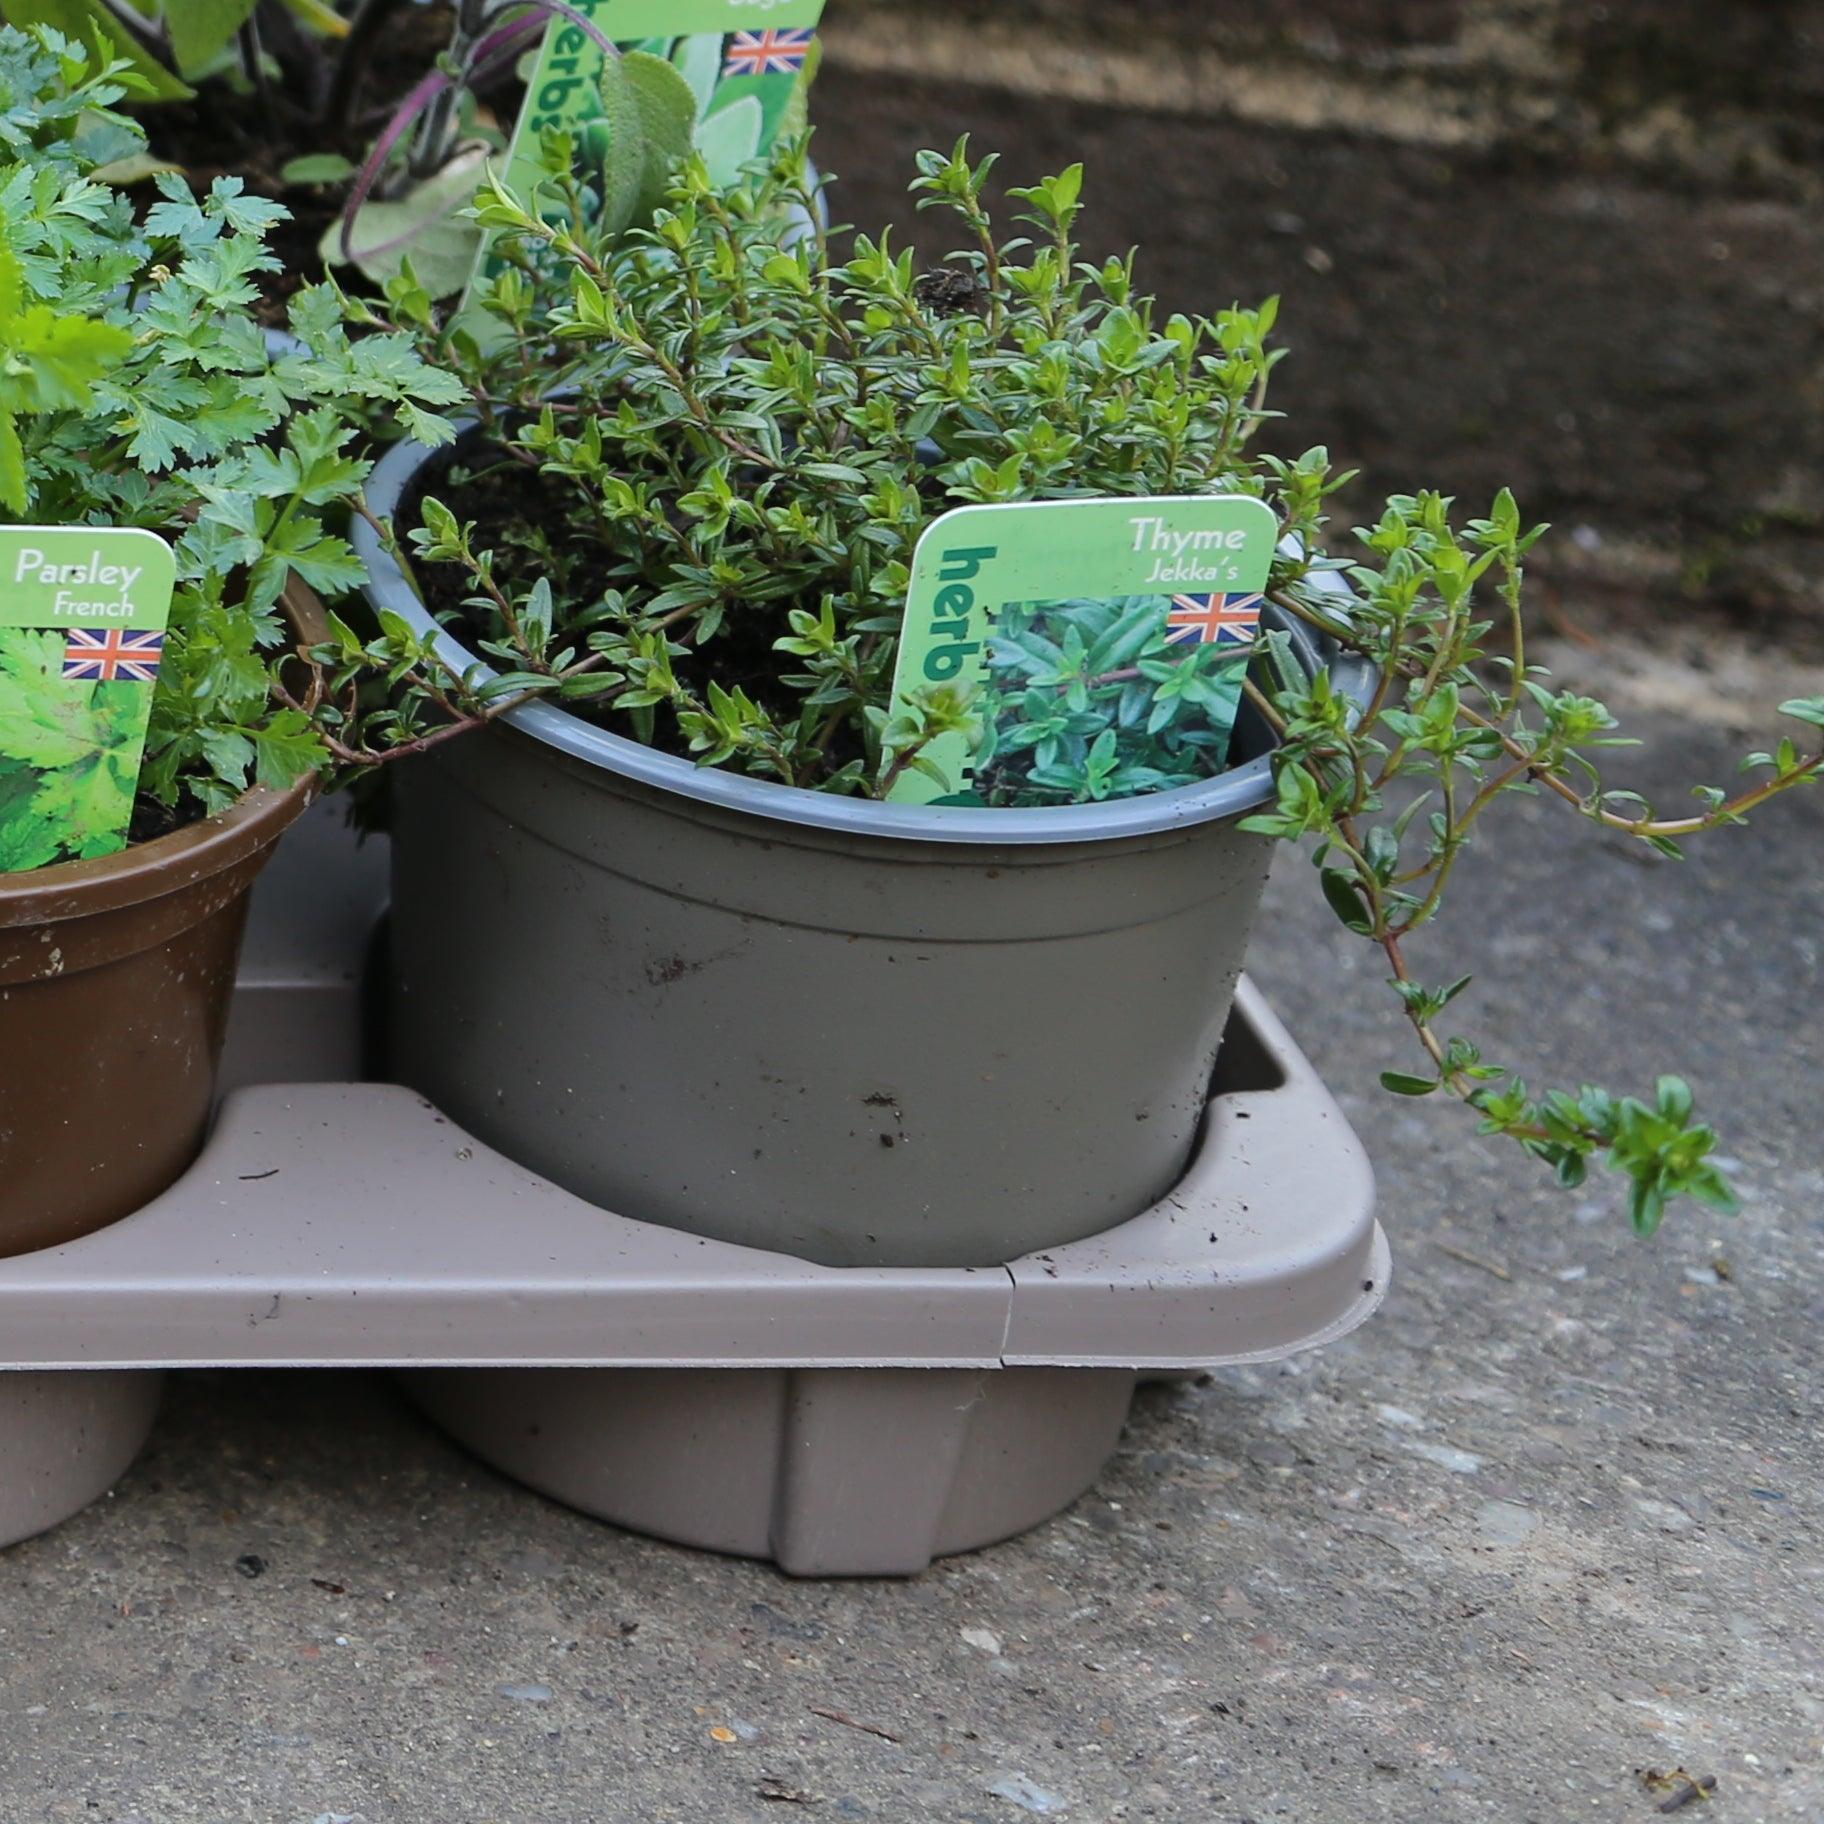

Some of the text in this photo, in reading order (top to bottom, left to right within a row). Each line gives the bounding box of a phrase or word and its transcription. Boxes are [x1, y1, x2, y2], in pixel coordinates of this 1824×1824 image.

[1128, 516, 1248, 556] Thyme
[14, 548, 144, 594] Parsley
[1145, 556, 1239, 584] Jekka's
[54, 590, 135, 618] French
[923, 544, 998, 682] herb
